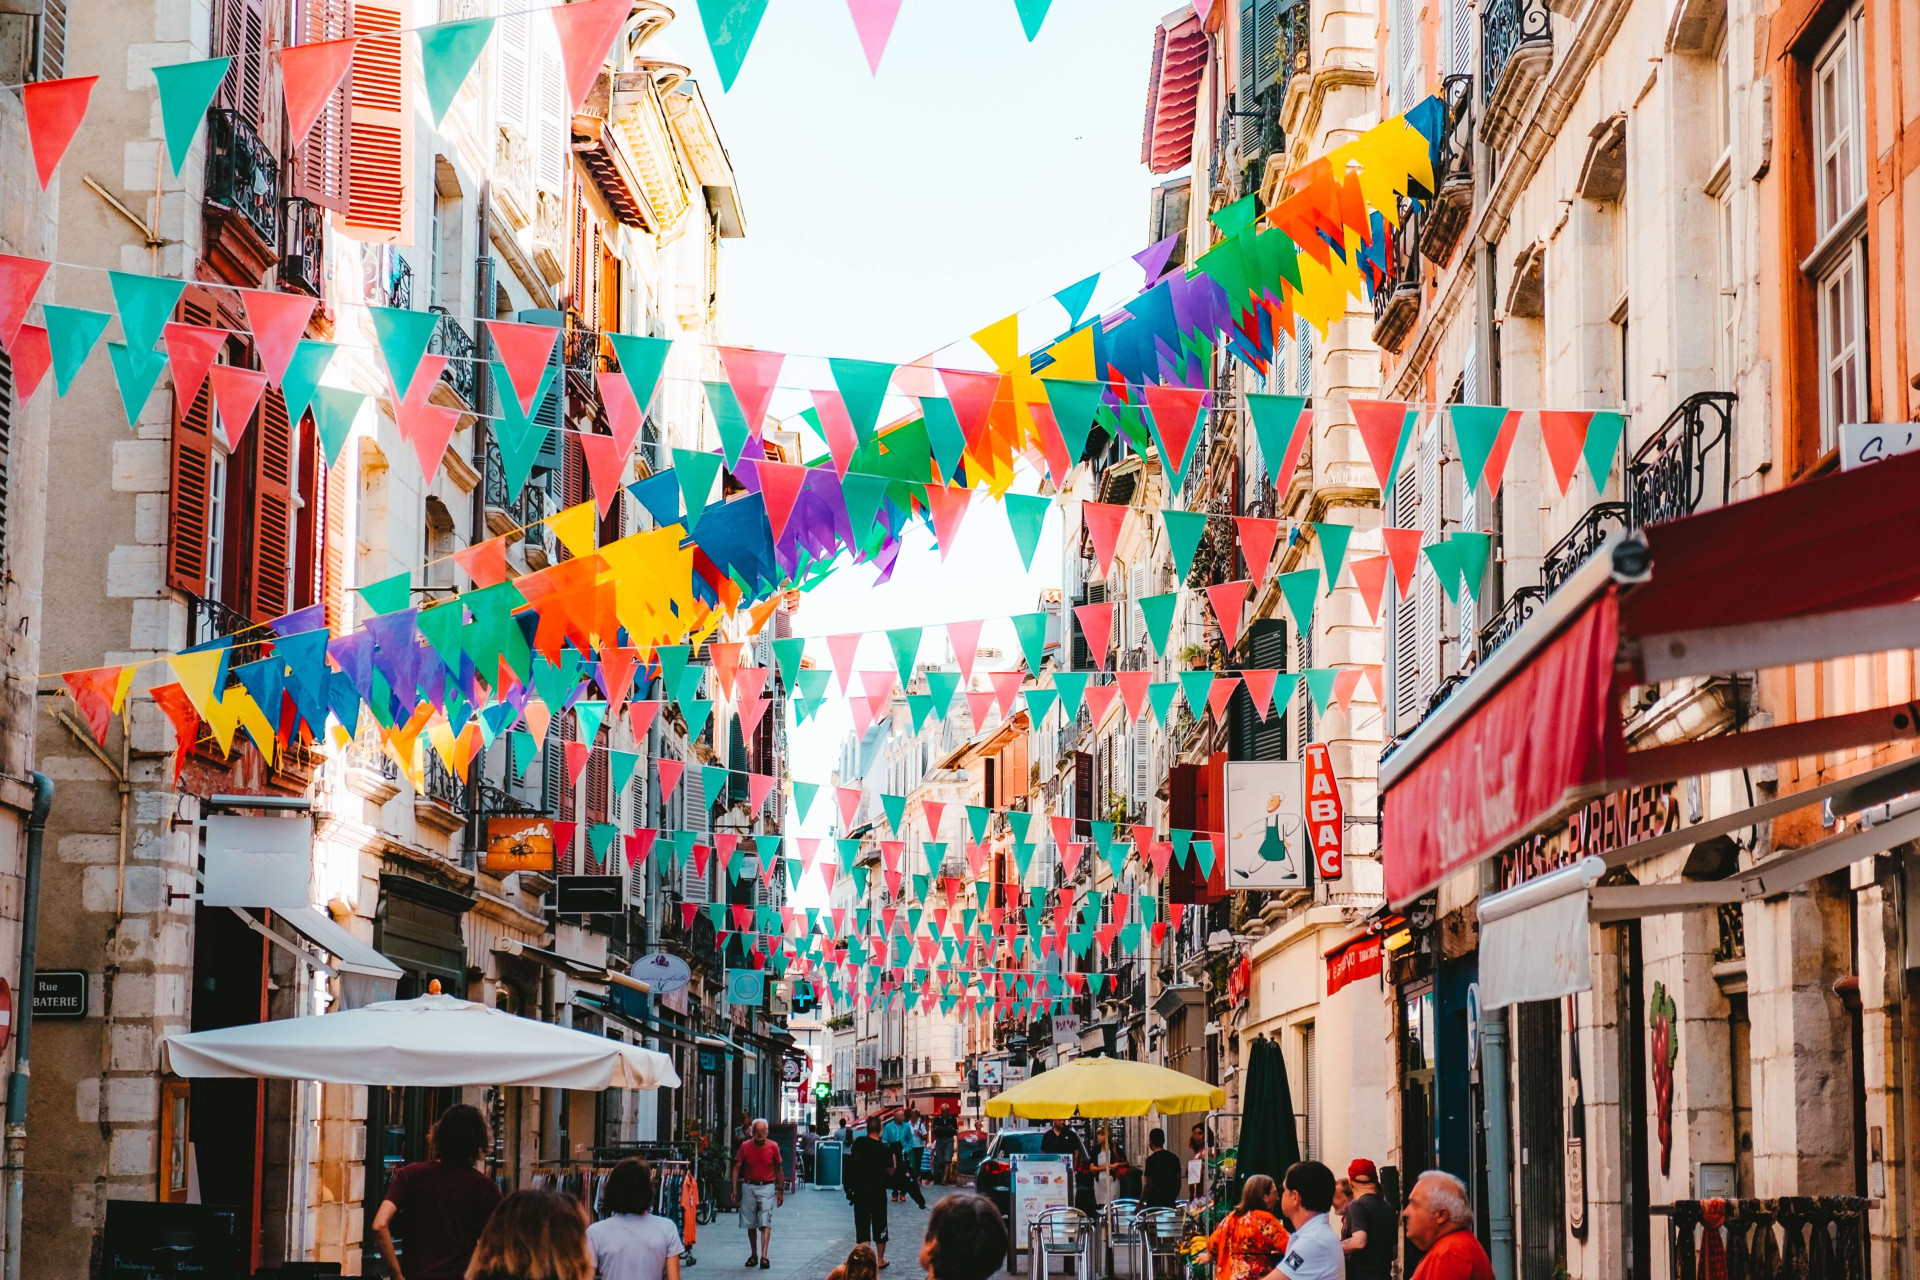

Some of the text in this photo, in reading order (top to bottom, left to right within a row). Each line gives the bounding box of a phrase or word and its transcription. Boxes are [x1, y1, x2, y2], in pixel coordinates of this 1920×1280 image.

[1308, 747, 1340, 873] TABAC
[39, 981, 58, 991] Rue
[33, 996, 78, 1007] BATERIE
